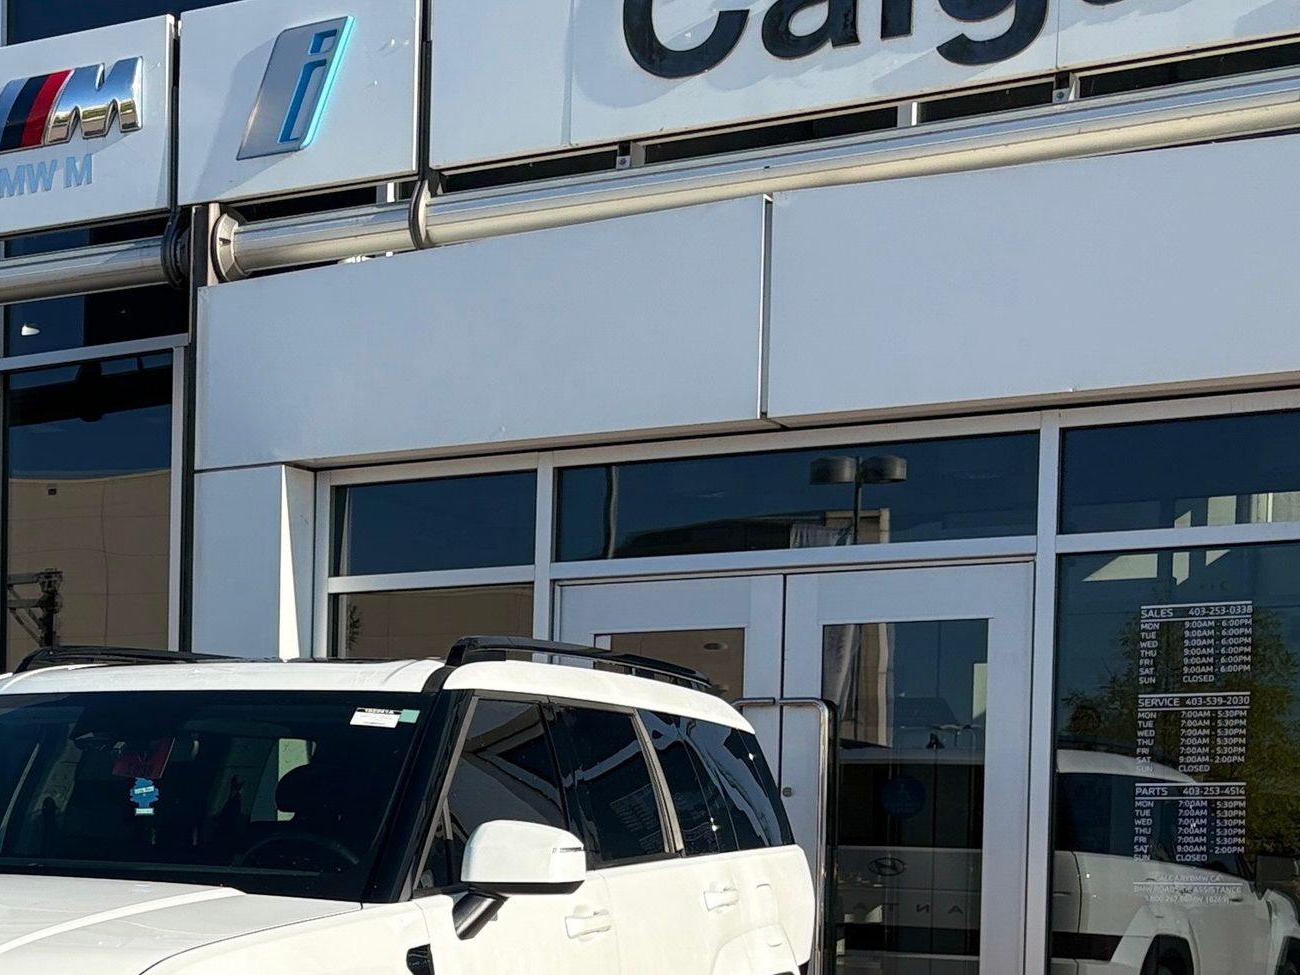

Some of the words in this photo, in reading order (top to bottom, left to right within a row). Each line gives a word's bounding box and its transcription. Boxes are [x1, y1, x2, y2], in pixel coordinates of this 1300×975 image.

[62, 153, 93, 189] M
[1141, 609, 1174, 618] SALES
[1189, 605, 1252, 616] 403-253-0338
[1185, 620, 1214, 628] 9:00AM
[1222, 618, 1252, 626] 6:00PM
[1184, 629, 1214, 638] 9:00AM
[1221, 628, 1252, 636] 6:00PM
[1184, 639, 1214, 647] 9:00AM
[1221, 637, 1252, 645] 6:00PM
[1184, 648, 1214, 656] 9:00AM
[1221, 646, 1251, 654] 6:00PM
[1183, 675, 1214, 683] CLOSED
[1138, 698, 1180, 707] SERVICE
[1186, 696, 1249, 705] 403-539-2030
[1217, 719, 1246, 727] 5:30PM
[1217, 728, 1246, 736] 5:30PM
[1217, 737, 1246, 745] 5:30PM
[1136, 787, 1168, 795] PARTS
[1183, 787, 1245, 795] 403-253-4514
[1216, 819, 1245, 827] 5:30PM
[1216, 828, 1245, 836] 5:30PM
[1216, 837, 1245, 845] 5:30PM
[1215, 846, 1244, 854] 2:00PM
